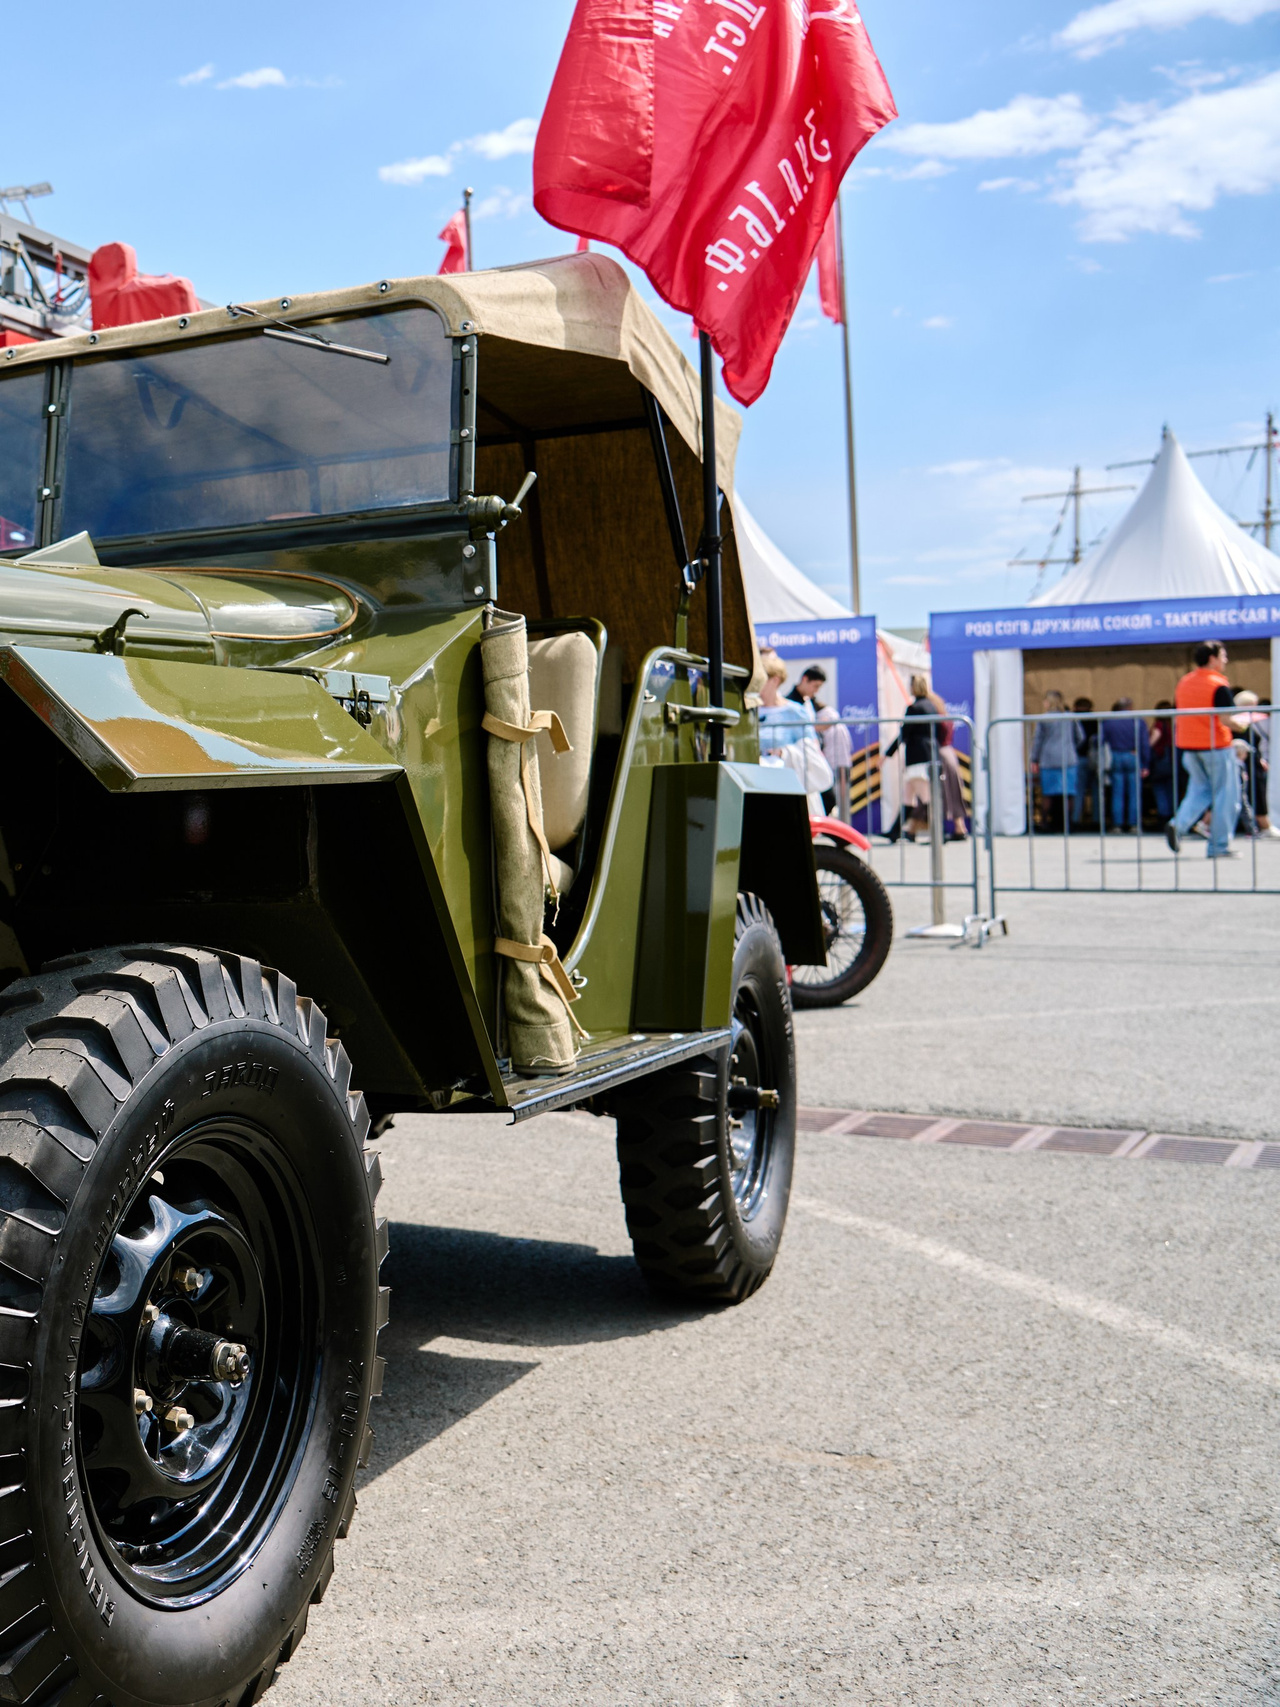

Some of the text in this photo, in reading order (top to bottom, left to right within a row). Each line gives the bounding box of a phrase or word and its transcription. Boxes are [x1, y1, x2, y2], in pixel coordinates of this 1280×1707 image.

[816, 629, 838, 645] МО
[839, 627, 861, 644] РФ
[1031, 617, 1101, 636] ДРУЖИНА
[1103, 614, 1153, 631] СОКОЛ
[1163, 607, 1268, 629] ТАКТИЧЕСКАЯ
[92, 1098, 175, 1258] ШИННЫЙ
[201, 1060, 280, 1101] ЗАВОД
